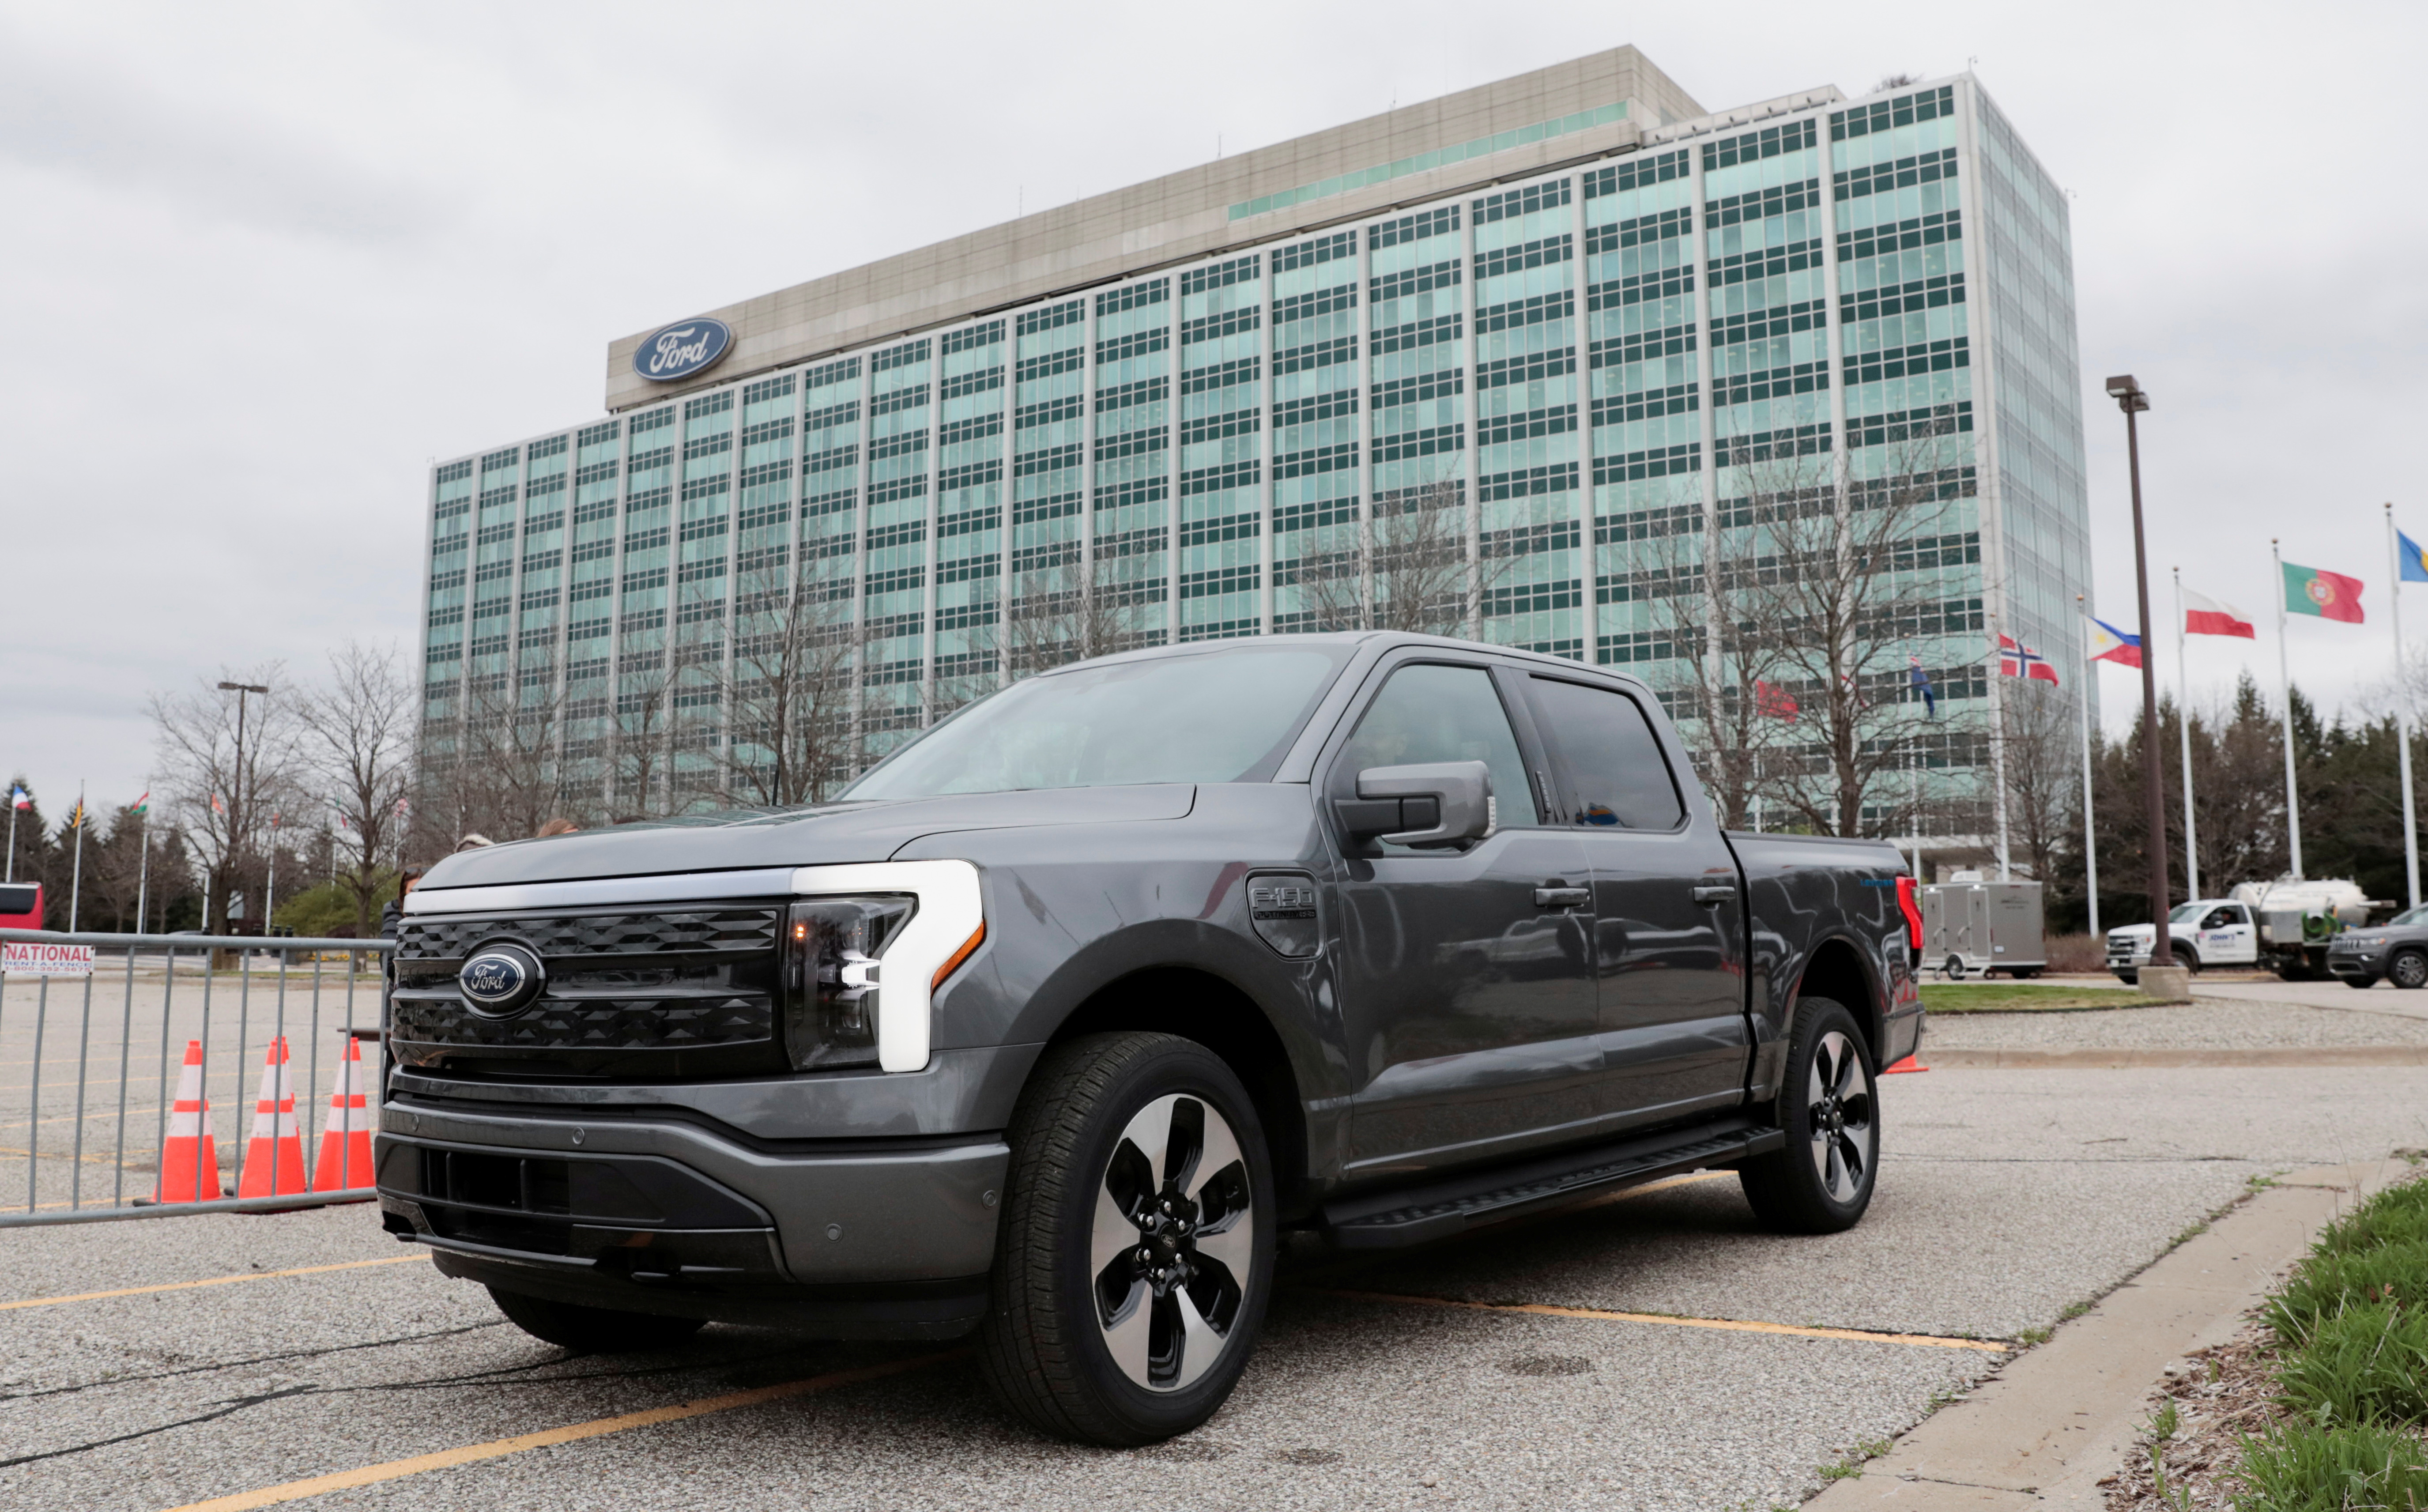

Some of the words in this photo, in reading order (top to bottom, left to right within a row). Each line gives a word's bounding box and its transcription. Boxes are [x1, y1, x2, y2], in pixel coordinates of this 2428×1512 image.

[650, 327, 710, 373] Ford
[1251, 888, 1315, 908] F-150
[6, 945, 91, 961] NATIONAL
[471, 964, 506, 990] Ford
